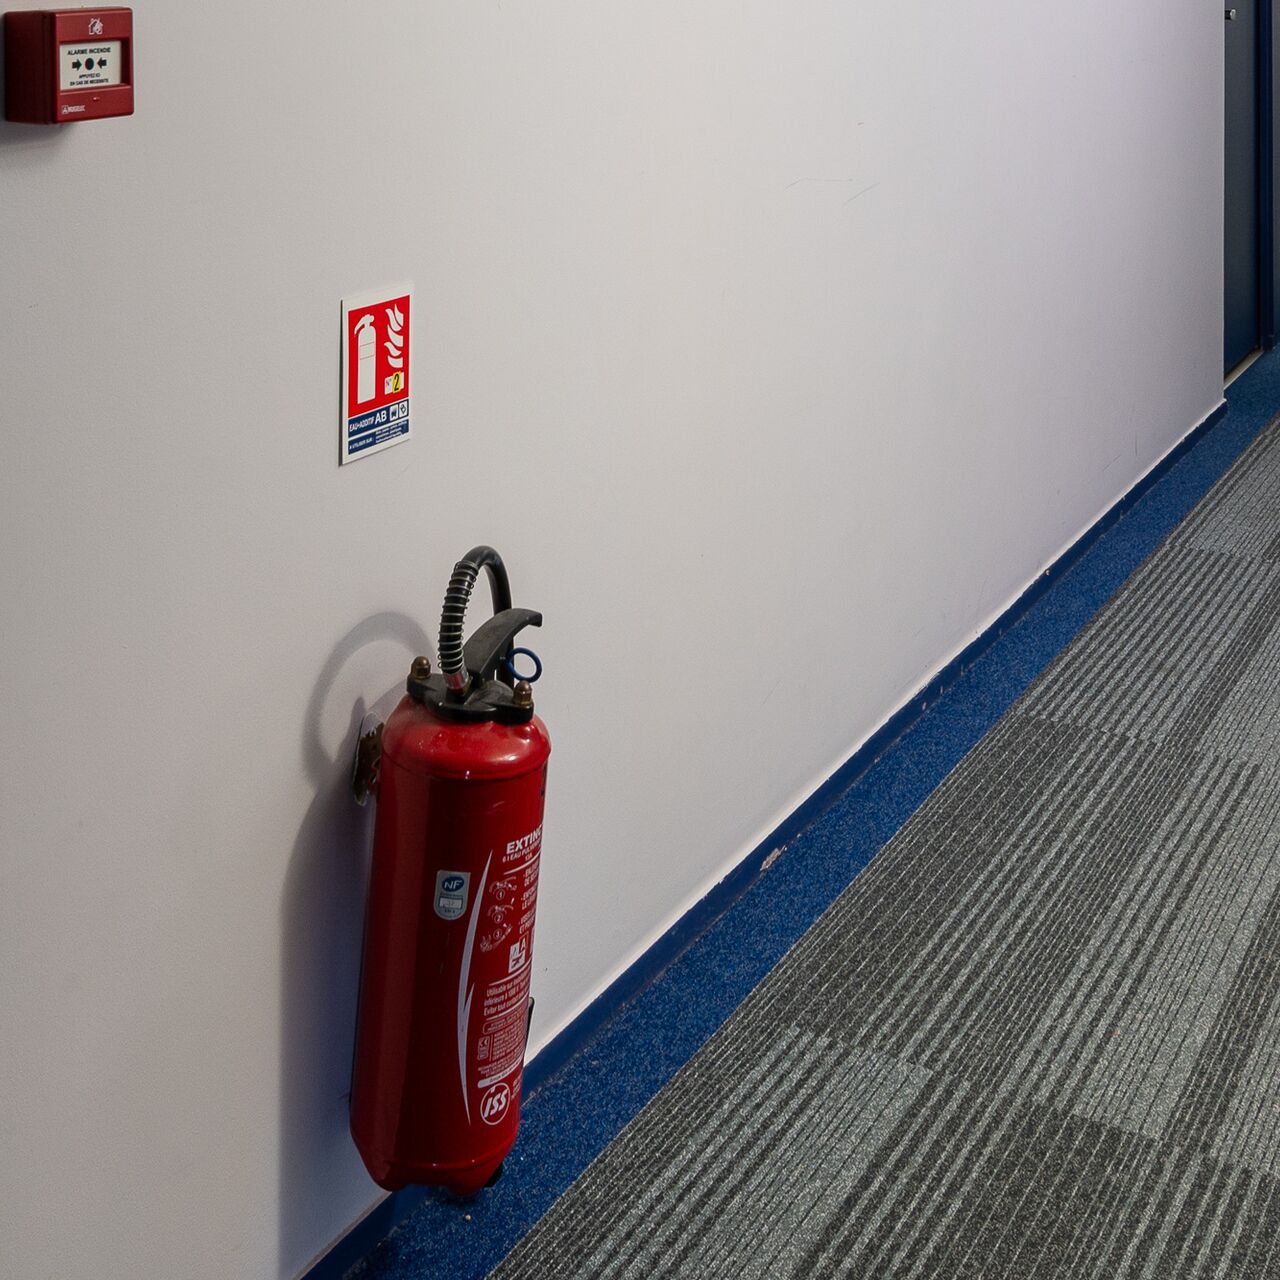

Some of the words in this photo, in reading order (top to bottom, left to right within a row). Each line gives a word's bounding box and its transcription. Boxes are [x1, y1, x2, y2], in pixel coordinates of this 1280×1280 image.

[394, 373, 400, 391] 2
[375, 410, 387, 425] AB
[444, 879, 463, 889] NF
